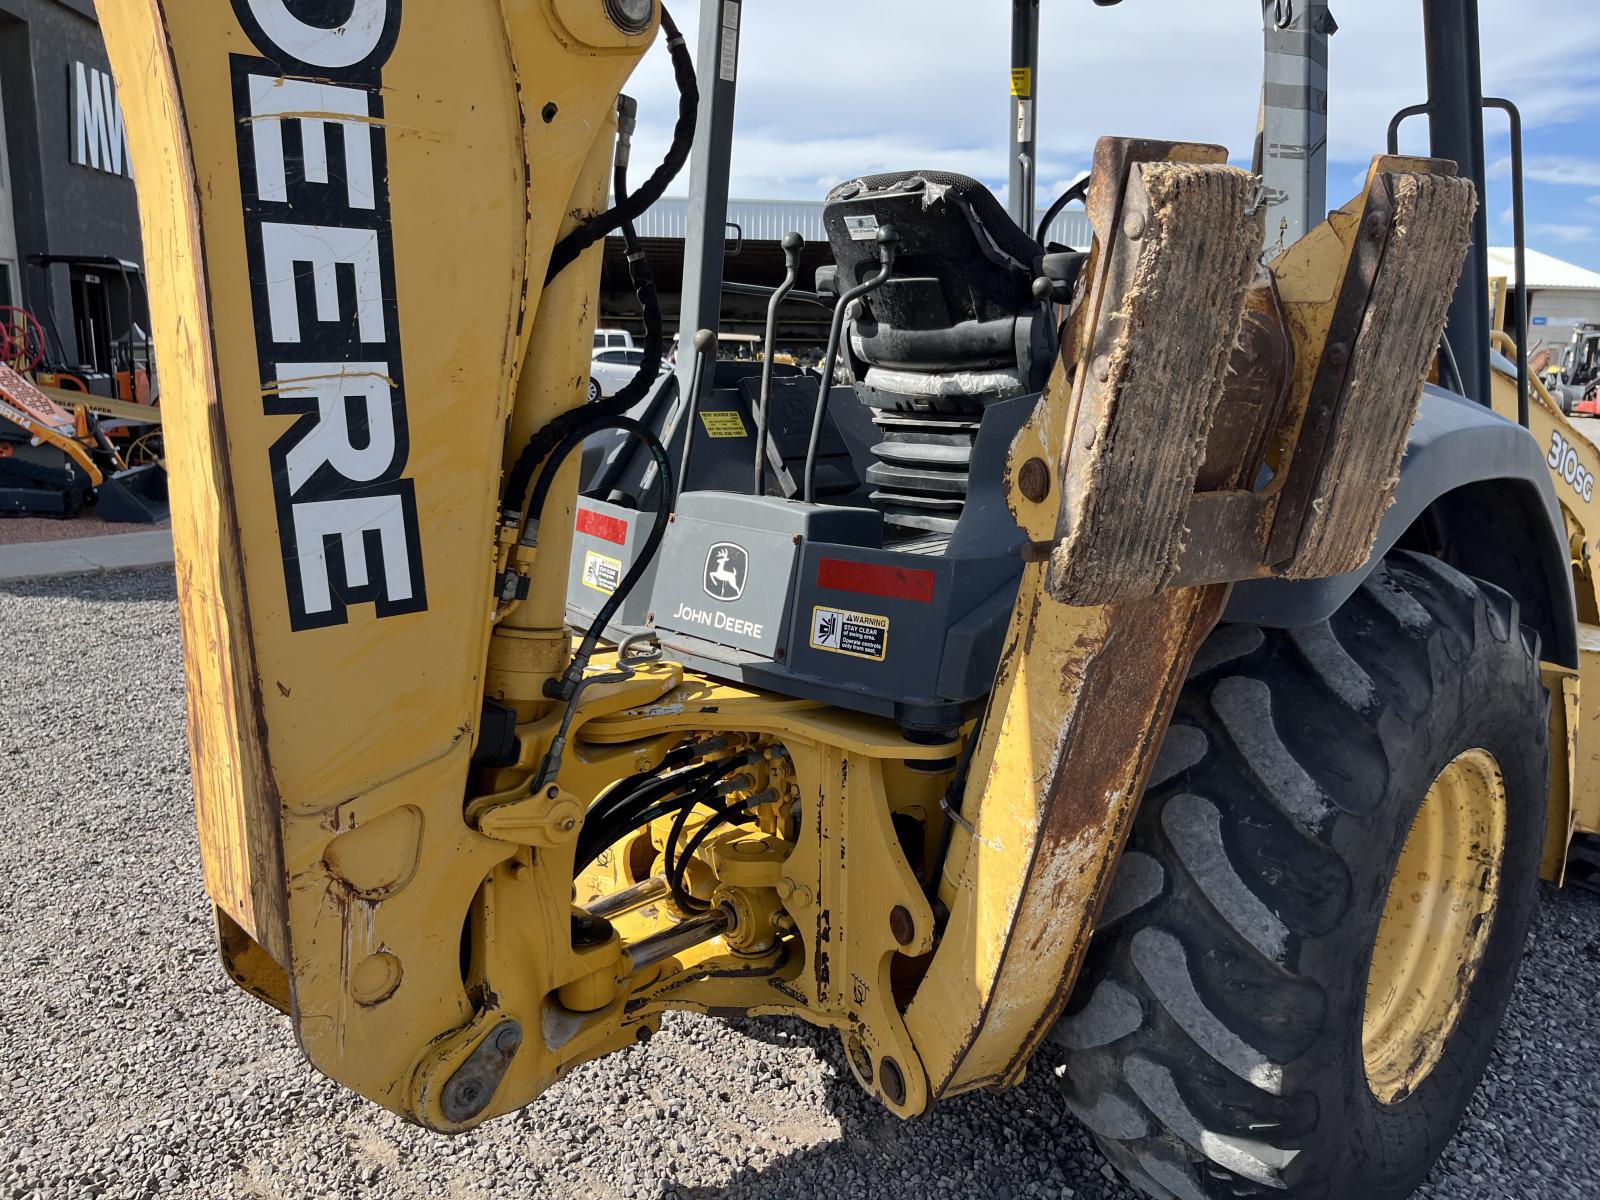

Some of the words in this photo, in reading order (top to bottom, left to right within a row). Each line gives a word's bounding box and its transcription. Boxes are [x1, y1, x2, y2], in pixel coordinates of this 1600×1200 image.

[1547, 429, 1594, 504] 310SG
[673, 602, 712, 626] JOHN
[714, 610, 763, 639] DEERE
[853, 614, 886, 627] WARNING
[843, 624, 858, 632] STAY
[858, 625, 878, 635] CLEAR
[843, 637, 861, 646] Operate
[861, 641, 882, 650] controls
